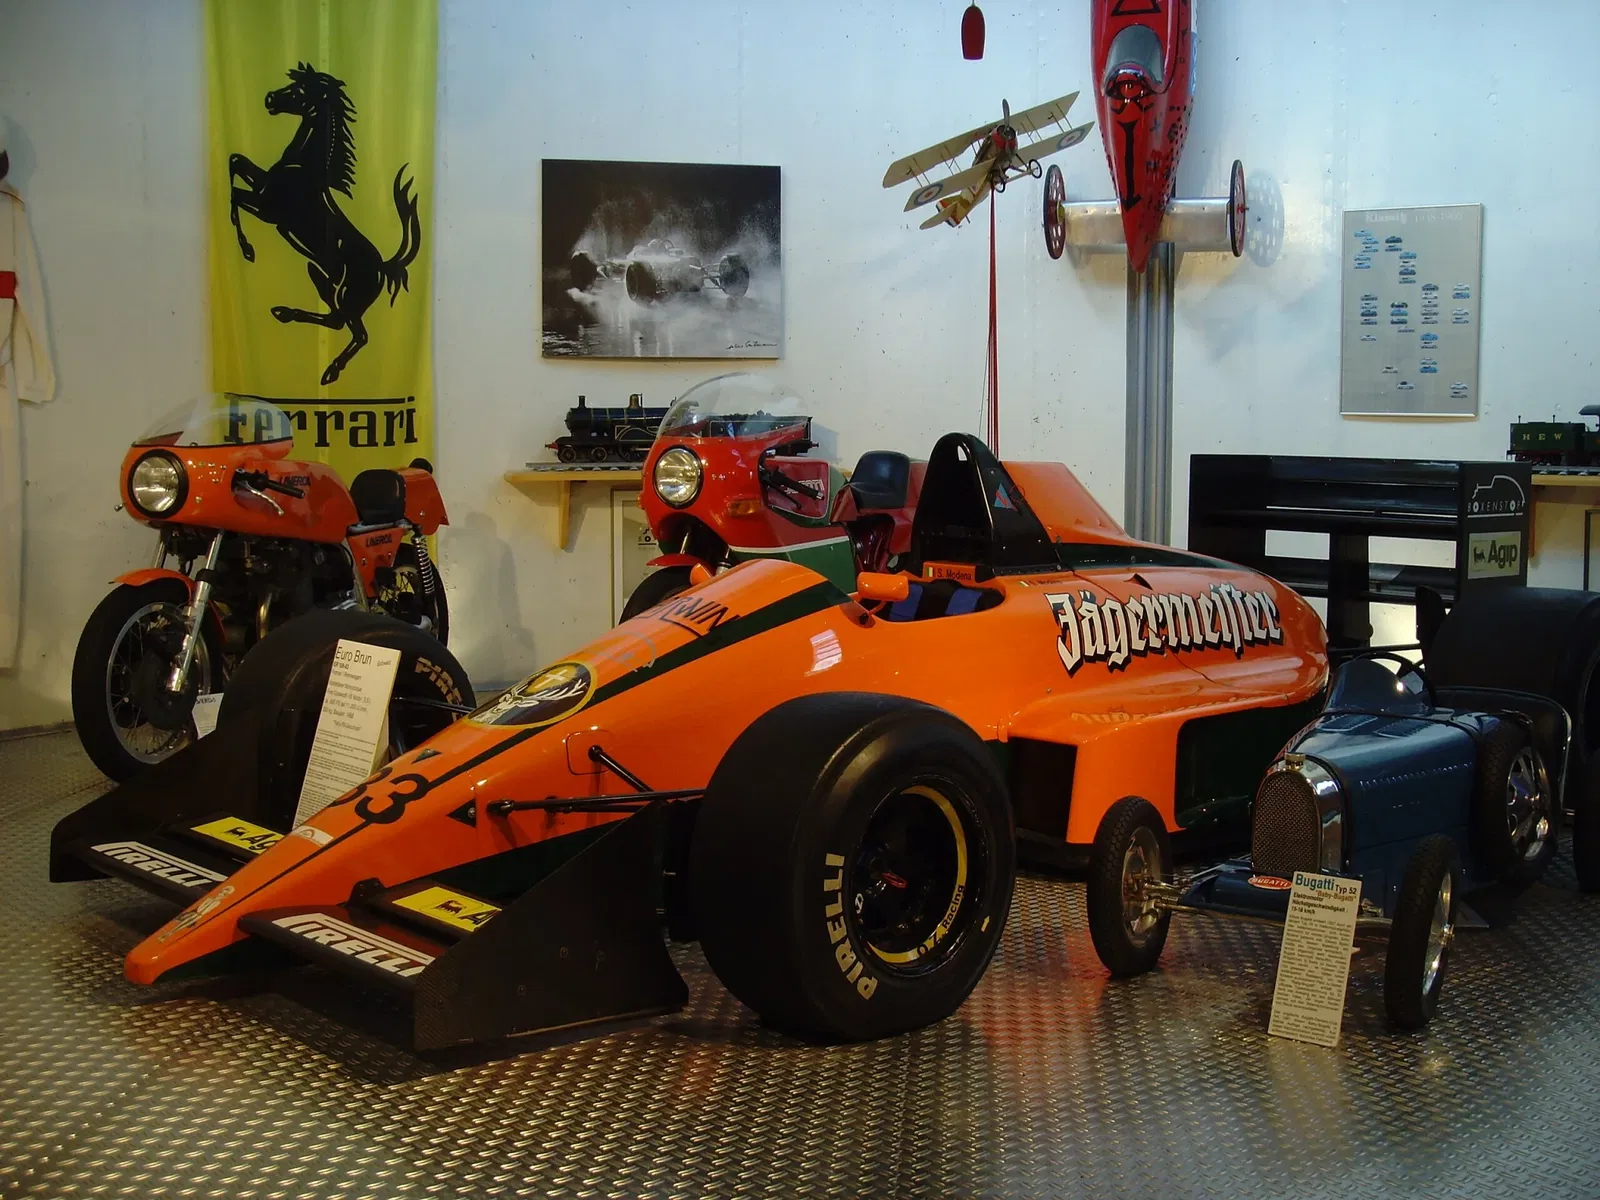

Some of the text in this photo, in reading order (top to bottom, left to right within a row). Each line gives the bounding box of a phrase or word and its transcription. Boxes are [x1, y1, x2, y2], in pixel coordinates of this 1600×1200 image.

[223, 392, 418, 448] Ferrari
[1467, 500, 1526, 514] BOXENSTOP
[1487, 540, 1518, 569] Agip
[946, 571, 973, 582] Modena
[335, 646, 353, 662] Euro
[353, 649, 373, 666] Brun
[1251, 877, 1288, 888] BUGATTI
[1295, 873, 1357, 895] Bugatti Typ 52
[941, 884, 966, 929] Racing
[823, 852, 878, 1001] PIRELLI
